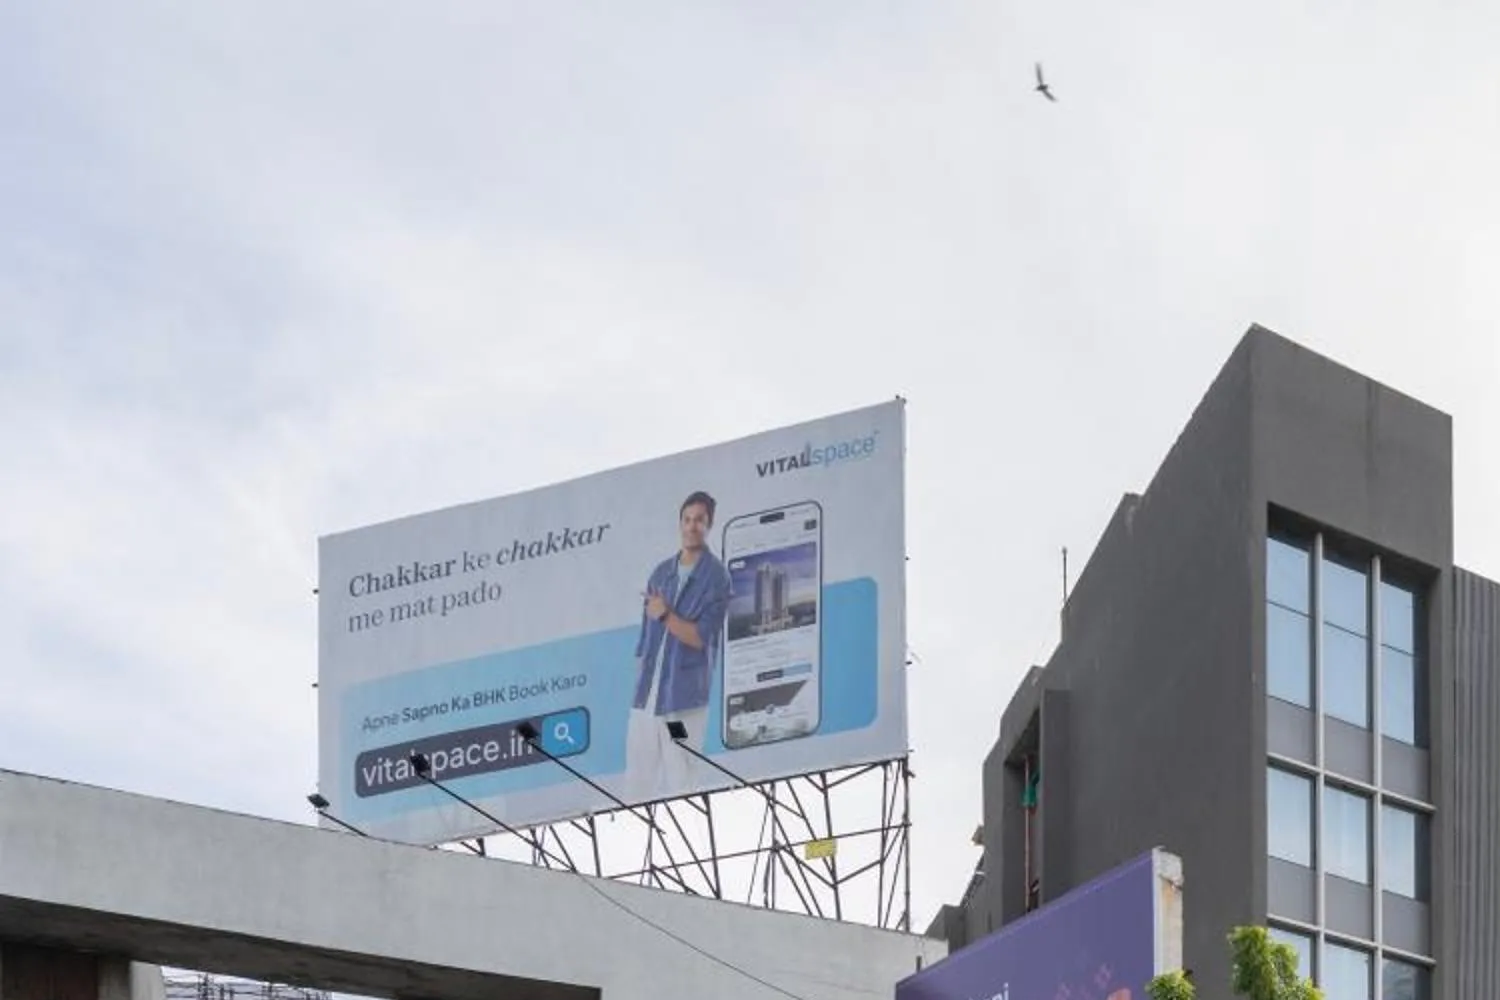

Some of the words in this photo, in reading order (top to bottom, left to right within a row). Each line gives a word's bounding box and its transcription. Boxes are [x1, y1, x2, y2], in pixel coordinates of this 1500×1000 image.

[349, 558, 457, 597] Chakkar
[462, 551, 491, 573] ke
[495, 523, 611, 566] chakkar
[348, 608, 384, 633] me
[389, 596, 435, 622] mat
[440, 580, 502, 616] pado
[401, 703, 448, 723] Sapno
[451, 695, 471, 712] Ka
[473, 689, 507, 707] BHK
[509, 682, 549, 701] Book
[551, 673, 587, 691] Karo
